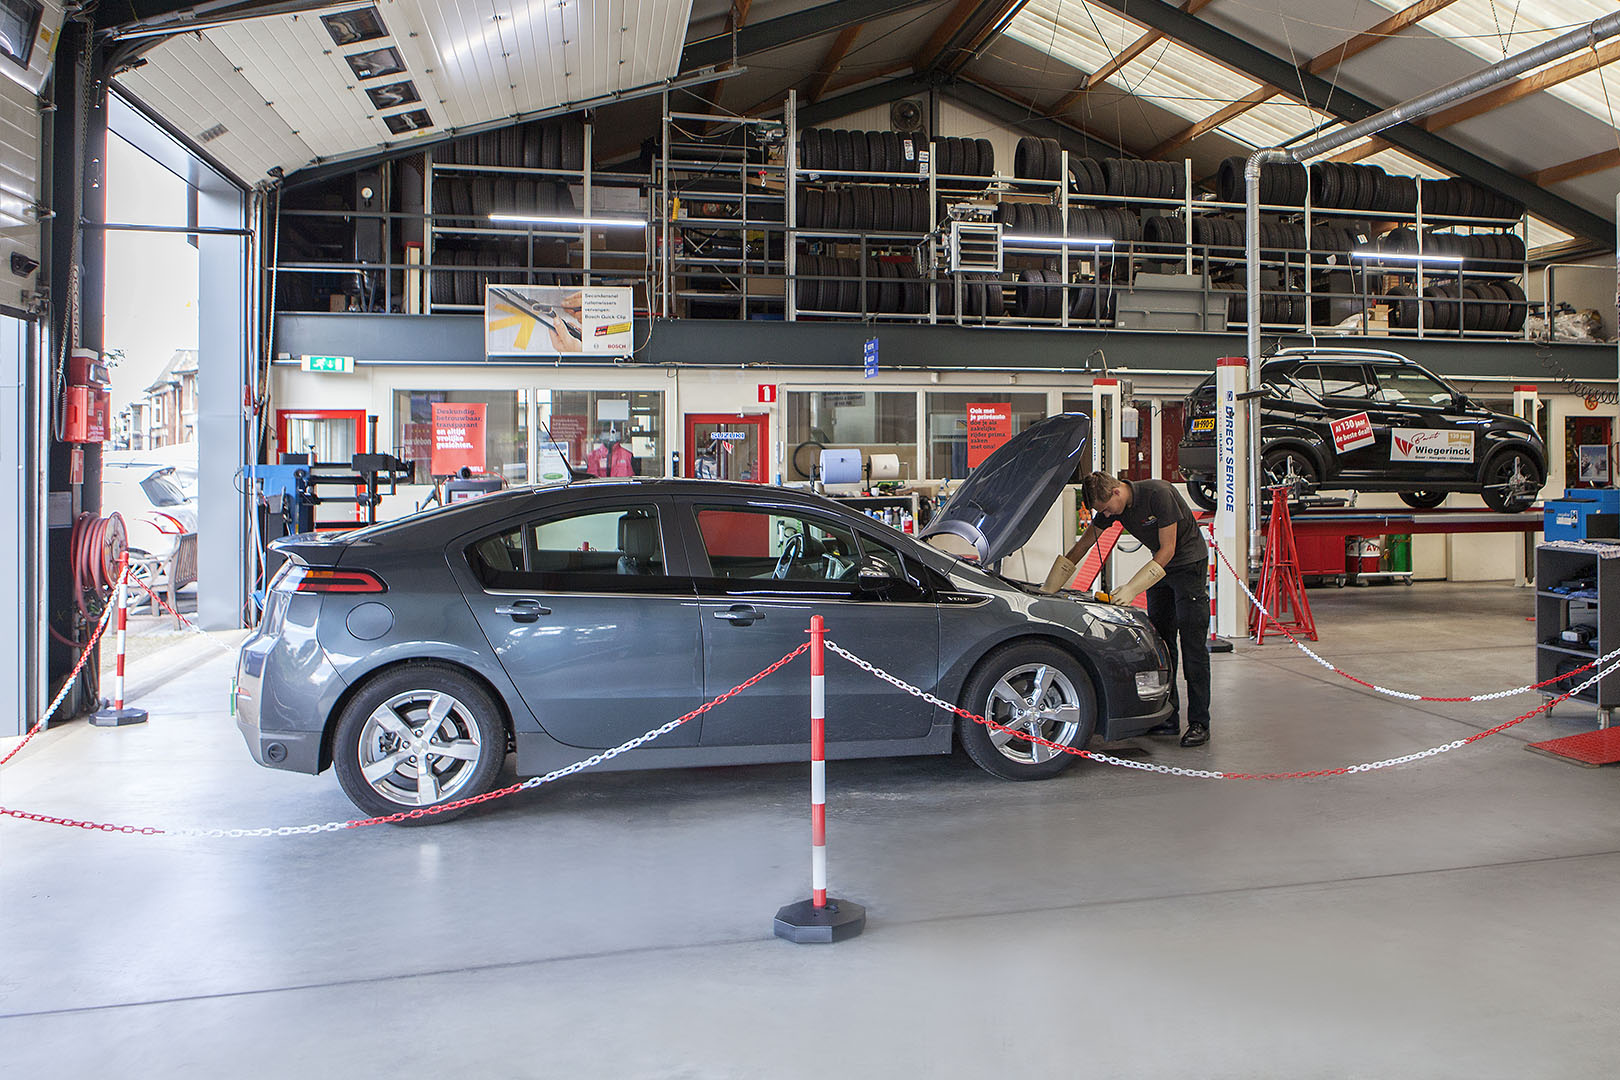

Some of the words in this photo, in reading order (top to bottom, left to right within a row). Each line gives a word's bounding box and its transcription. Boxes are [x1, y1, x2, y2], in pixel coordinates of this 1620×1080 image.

[762, 385, 771, 402] 1
[447, 428, 466, 436] altijd
[1225, 406, 1234, 454] DIRECT
[1335, 424, 1342, 433] Al
[1340, 419, 1355, 431] 130
[1355, 419, 1366, 429] jaar
[436, 435, 464, 443] vrolijke
[711, 432, 746, 440] SUZUKI
[1336, 435, 1343, 443] de
[1343, 431, 1358, 441] beste
[1415, 446, 1470, 455] Wiegerinck
[1225, 457, 1234, 512] SERVICE
